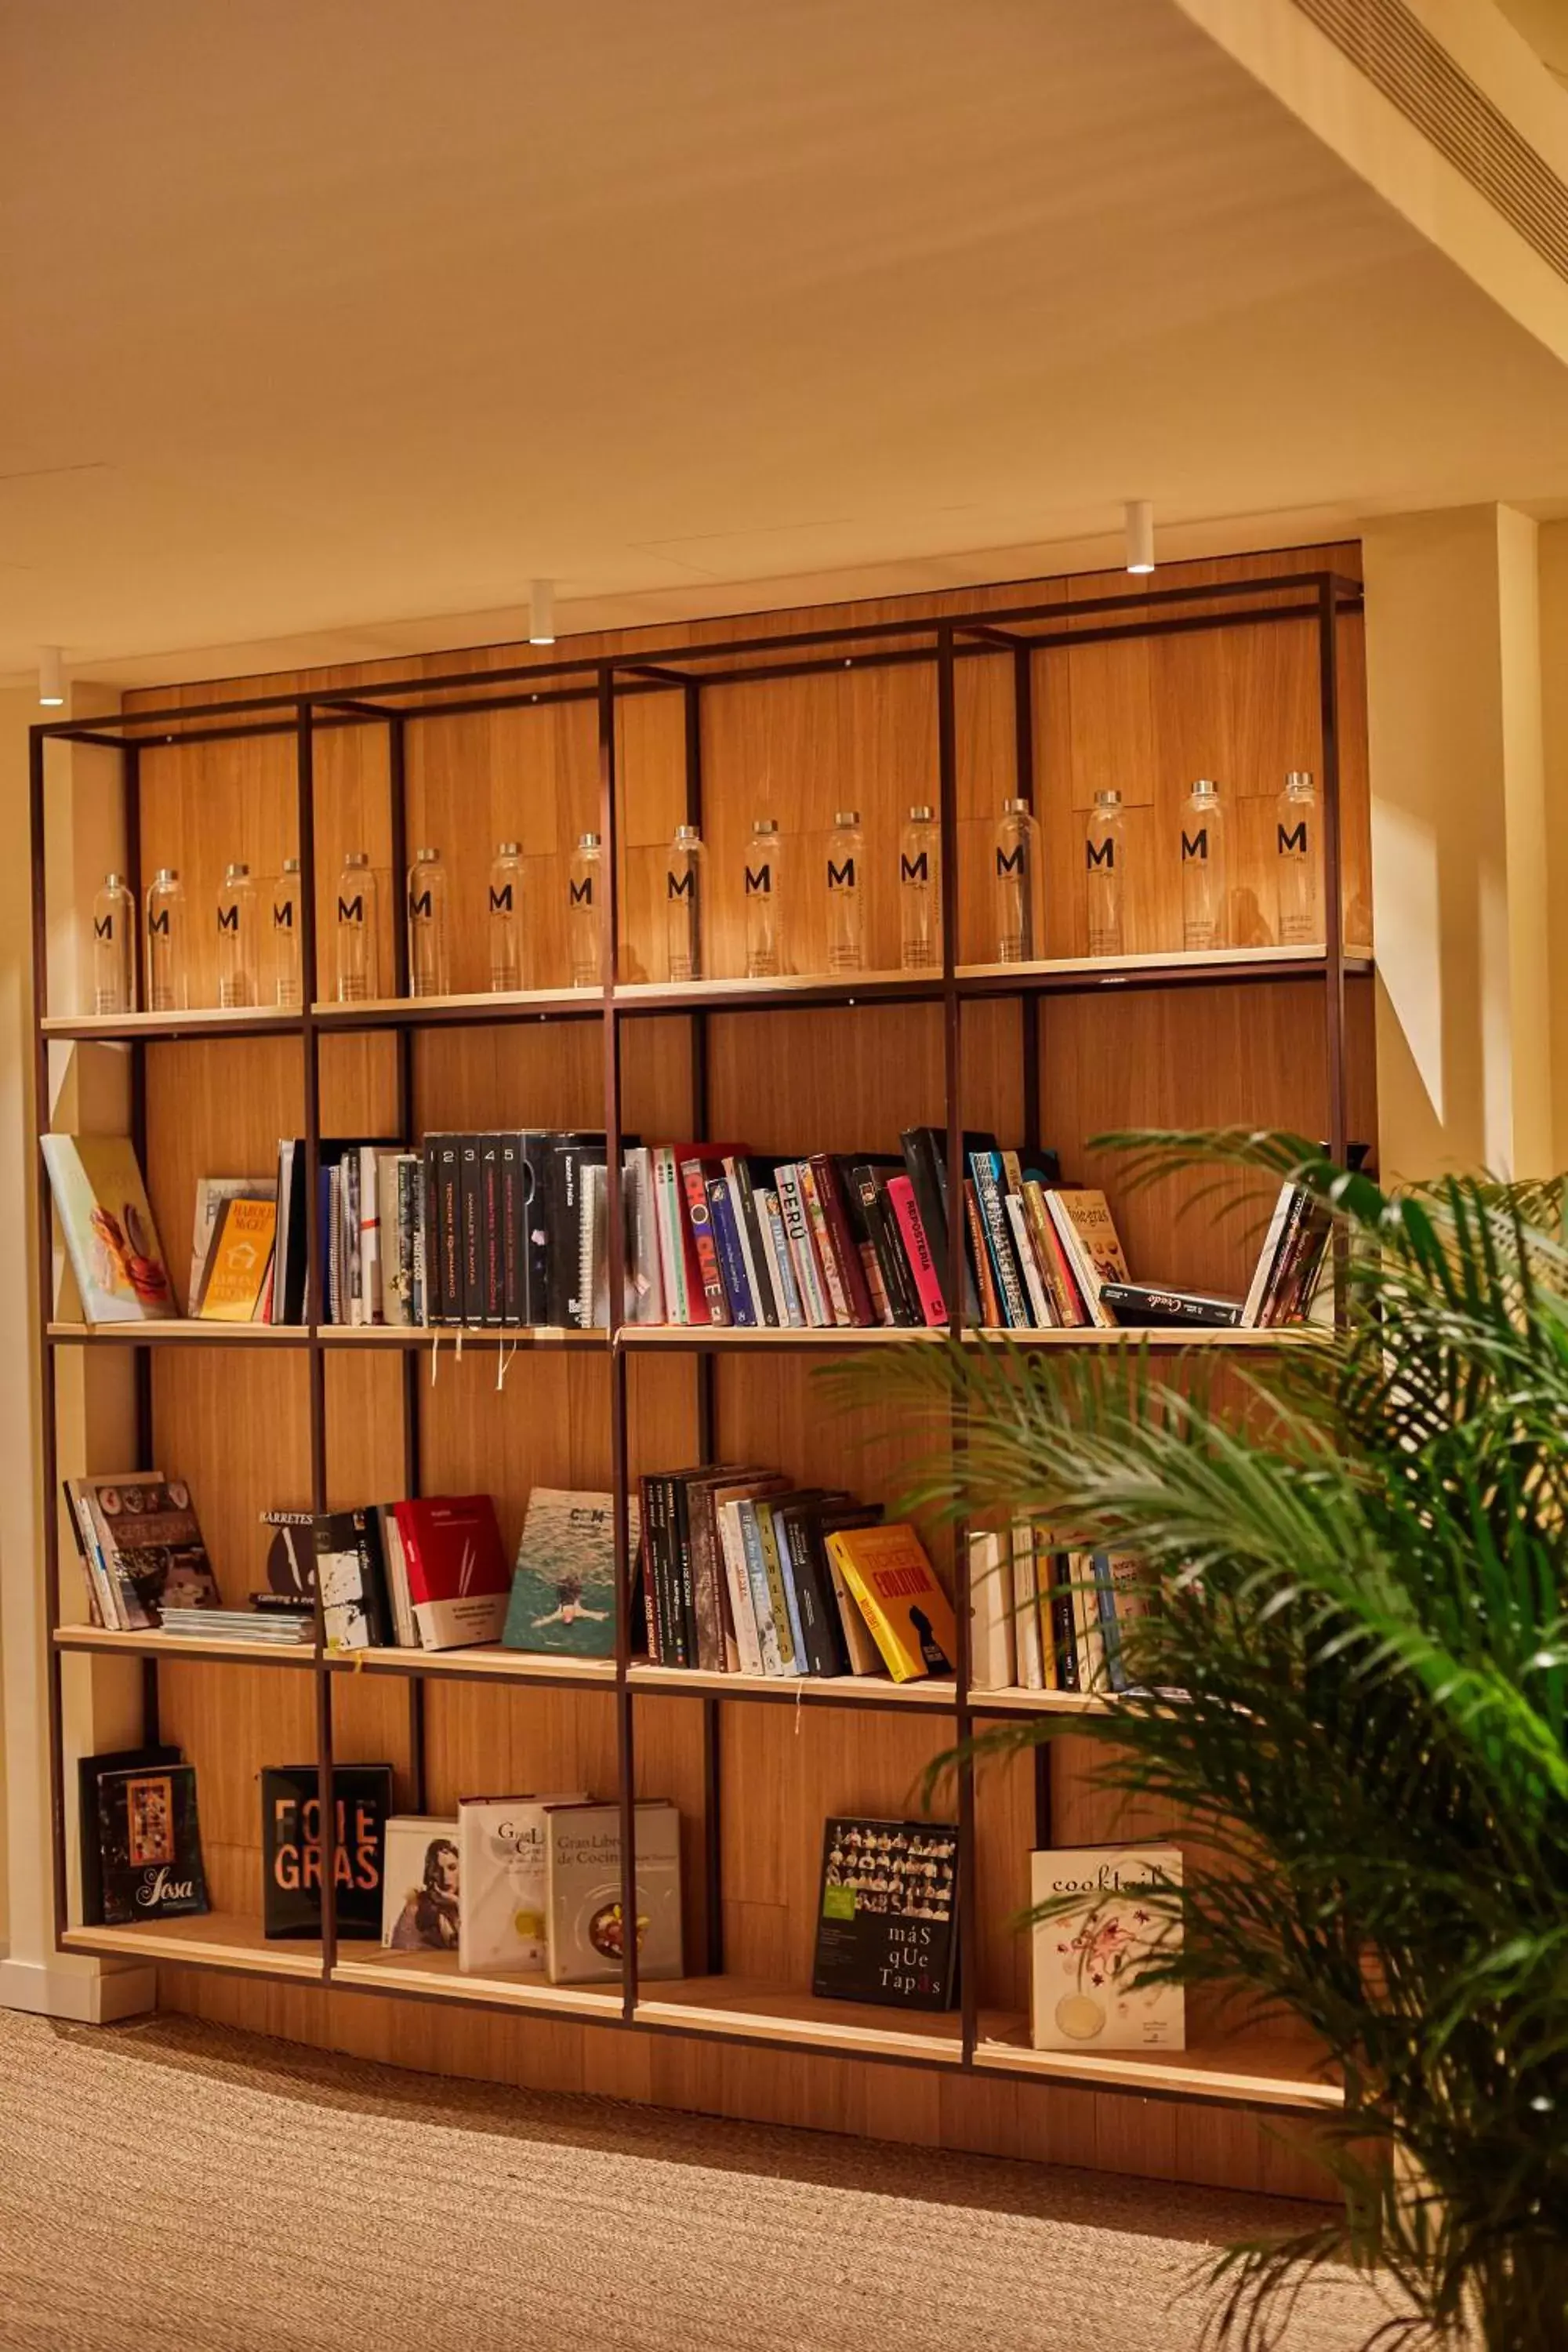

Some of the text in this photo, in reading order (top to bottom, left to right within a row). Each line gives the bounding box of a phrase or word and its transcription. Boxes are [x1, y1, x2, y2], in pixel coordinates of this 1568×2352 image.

[1182, 829, 1207, 859] M
[1278, 822, 1306, 854] M
[996, 844, 1024, 875] M
[1087, 837, 1113, 869] M
[746, 865, 770, 893] M
[827, 858, 855, 887] M
[902, 852, 927, 882] M
[489, 884, 512, 911] M
[570, 877, 591, 905] M
[668, 870, 694, 898] M
[274, 902, 292, 927] M
[339, 895, 362, 922] M
[409, 891, 430, 917] M
[94, 915, 112, 939] M
[149, 909, 169, 935] M
[217, 905, 238, 931] M
[442, 1149, 455, 1162] 2
[464, 1149, 476, 1161] 3
[485, 1149, 495, 1161] 4
[504, 1148, 514, 1161] 5
[779, 1181, 807, 1240] PERÚ
[276, 1799, 379, 1844] FOIE
[557, 1835, 588, 1849] Gran
[275, 1844, 379, 1889] GRAS
[576, 1849, 620, 1865] Cocin
[136, 1867, 193, 1906] Sosa
